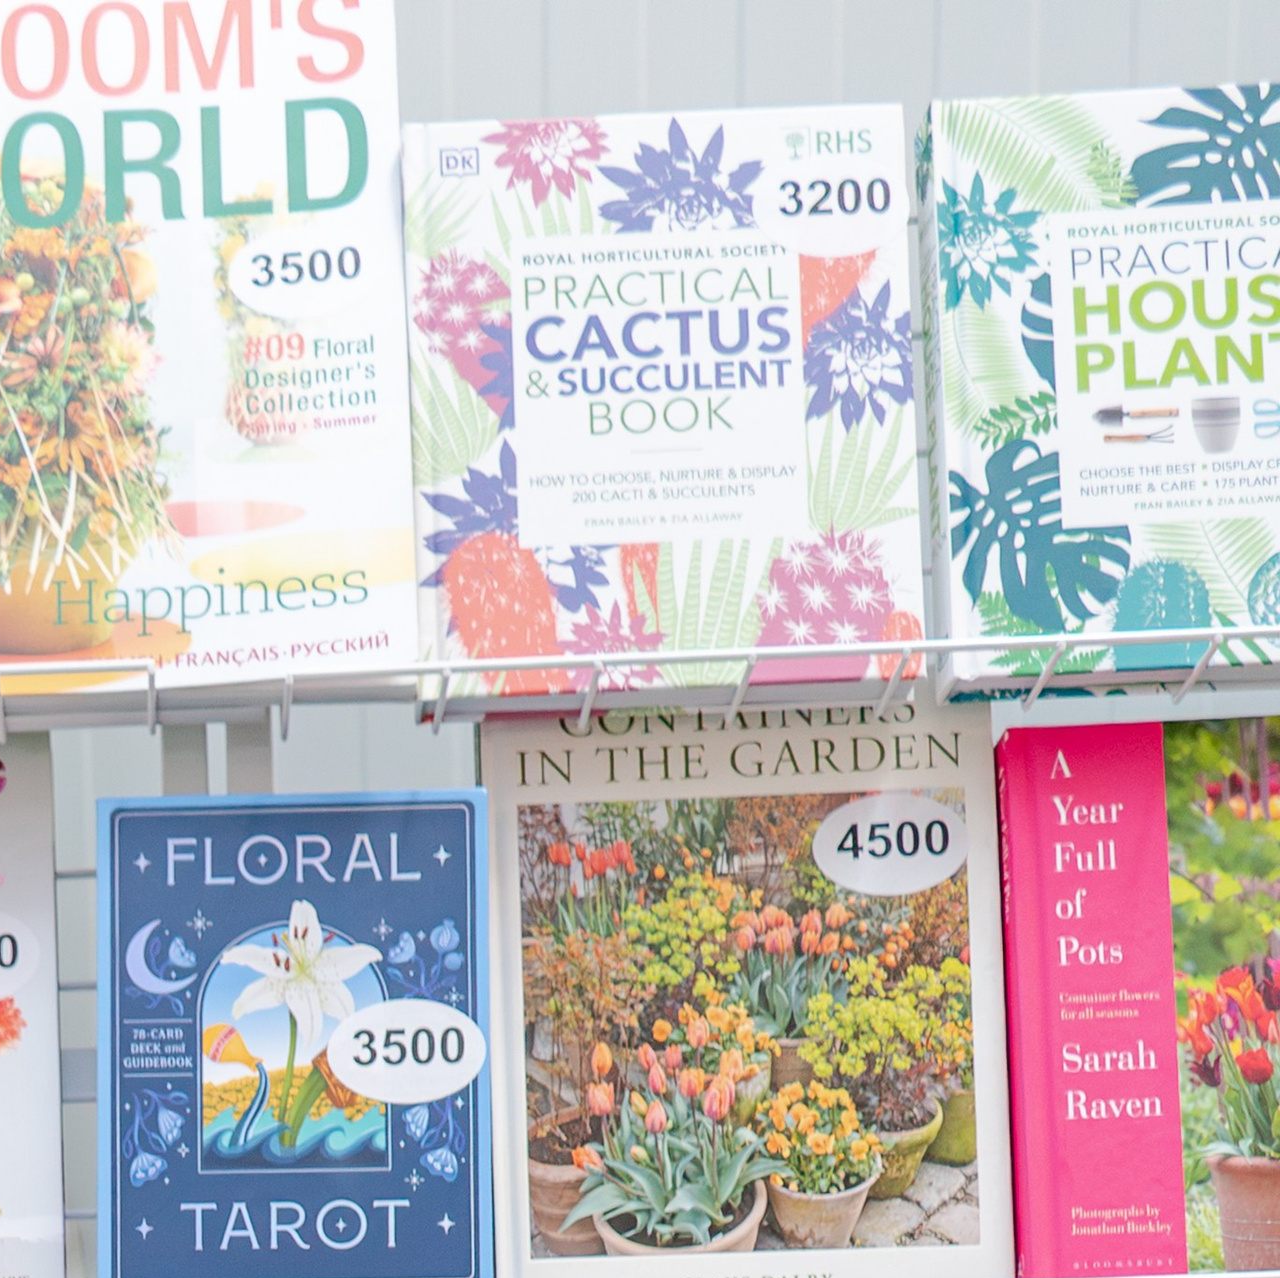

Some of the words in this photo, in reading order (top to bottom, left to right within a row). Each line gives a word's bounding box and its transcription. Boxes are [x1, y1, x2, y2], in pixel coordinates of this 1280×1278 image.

[816, 129, 872, 155] RHS
[445, 155, 474, 172] DK
[779, 178, 890, 216] 3200
[251, 248, 361, 288] 3500
[523, 251, 577, 266] ROYAL
[583, 246, 713, 263] HORTICULTURAL
[523, 268, 788, 311] PRACTICAL
[526, 306, 791, 363] CACTUS
[526, 372, 549, 396] &
[558, 360, 791, 394] SUCCULENT
[589, 395, 733, 435] BOOK
[53, 568, 369, 636] Happiness
[518, 750, 572, 786] IN
[596, 744, 709, 782] THE
[729, 733, 961, 776] GARDEN
[1051, 750, 1072, 780] A
[1051, 797, 1123, 827] Year
[837, 821, 949, 858] 4500
[1054, 841, 1117, 872] Full
[165, 833, 421, 886] FLORAL
[1056, 889, 1087, 920] of
[1057, 936, 1122, 966] Pots
[352, 1027, 465, 1066] 3500
[1062, 1042, 1157, 1072] Sarah
[1065, 1090, 1163, 1120] Raven
[180, 1200, 411, 1252] TAROT
